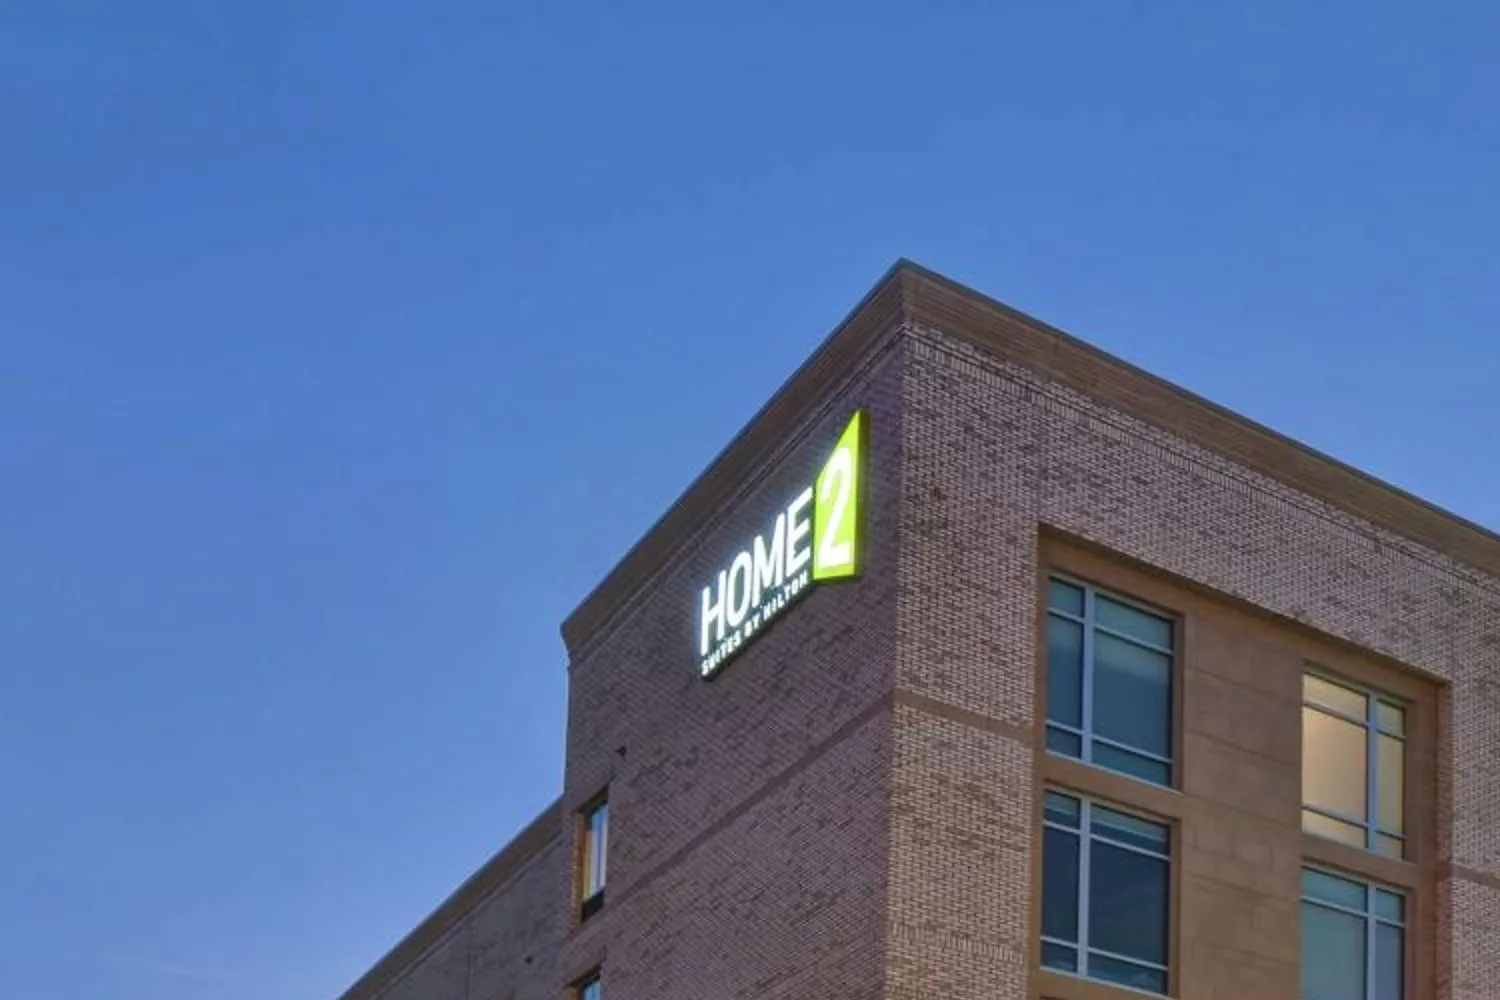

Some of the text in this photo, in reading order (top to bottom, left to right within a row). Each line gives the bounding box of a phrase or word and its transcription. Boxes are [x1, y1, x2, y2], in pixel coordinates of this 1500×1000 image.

[701, 569, 809, 677] SUITES BY HILTON
